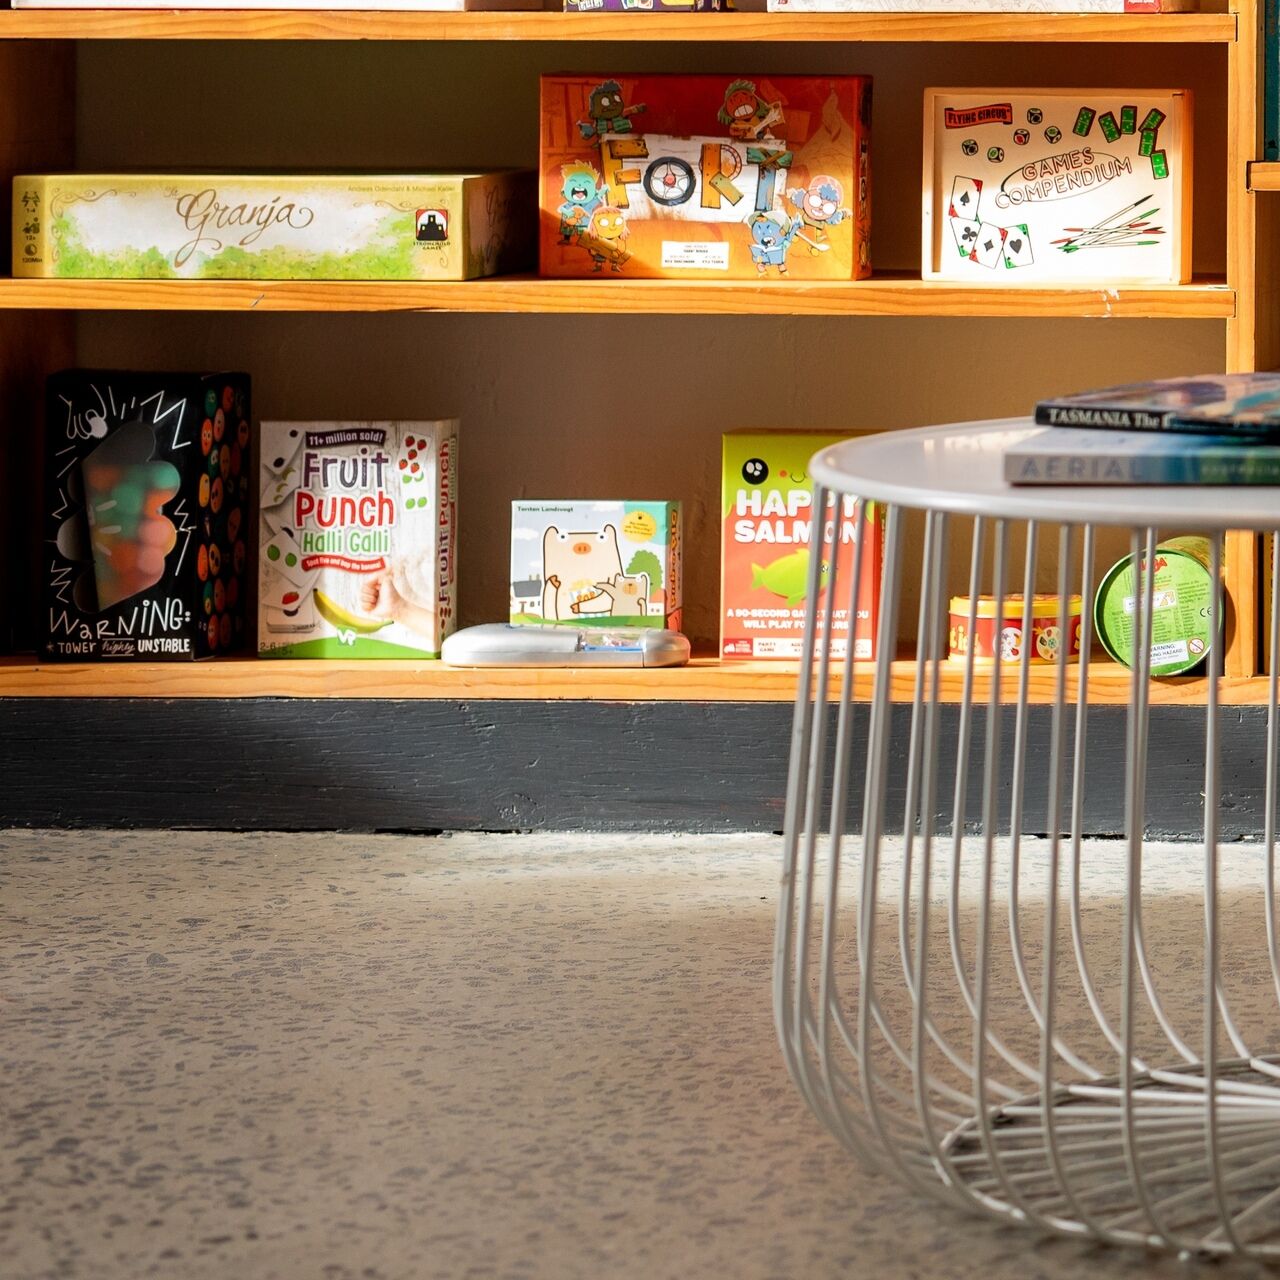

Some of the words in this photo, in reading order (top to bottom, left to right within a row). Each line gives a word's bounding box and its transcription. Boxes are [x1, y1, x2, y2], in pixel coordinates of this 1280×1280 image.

[948, 110, 976, 124] FLYING
[978, 108, 1009, 121] CIRCUS
[1022, 146, 1096, 181] GAMES
[994, 156, 1133, 209] COMPENDIUM
[174, 188, 314, 268] Granja
[1046, 408, 1132, 426] TASMANIA
[1134, 411, 1161, 428] The
[308, 435, 324, 446] 11+
[326, 431, 358, 444] million
[359, 430, 384, 444] sold!
[304, 447, 389, 488] Fruit
[1020, 456, 1144, 480] AERIAL
[296, 490, 394, 528] Punch
[304, 530, 342, 553] Halli
[350, 530, 389, 552] Galli
[102, 641, 136, 654] highly
[138, 638, 191, 653] UNSTABLE
